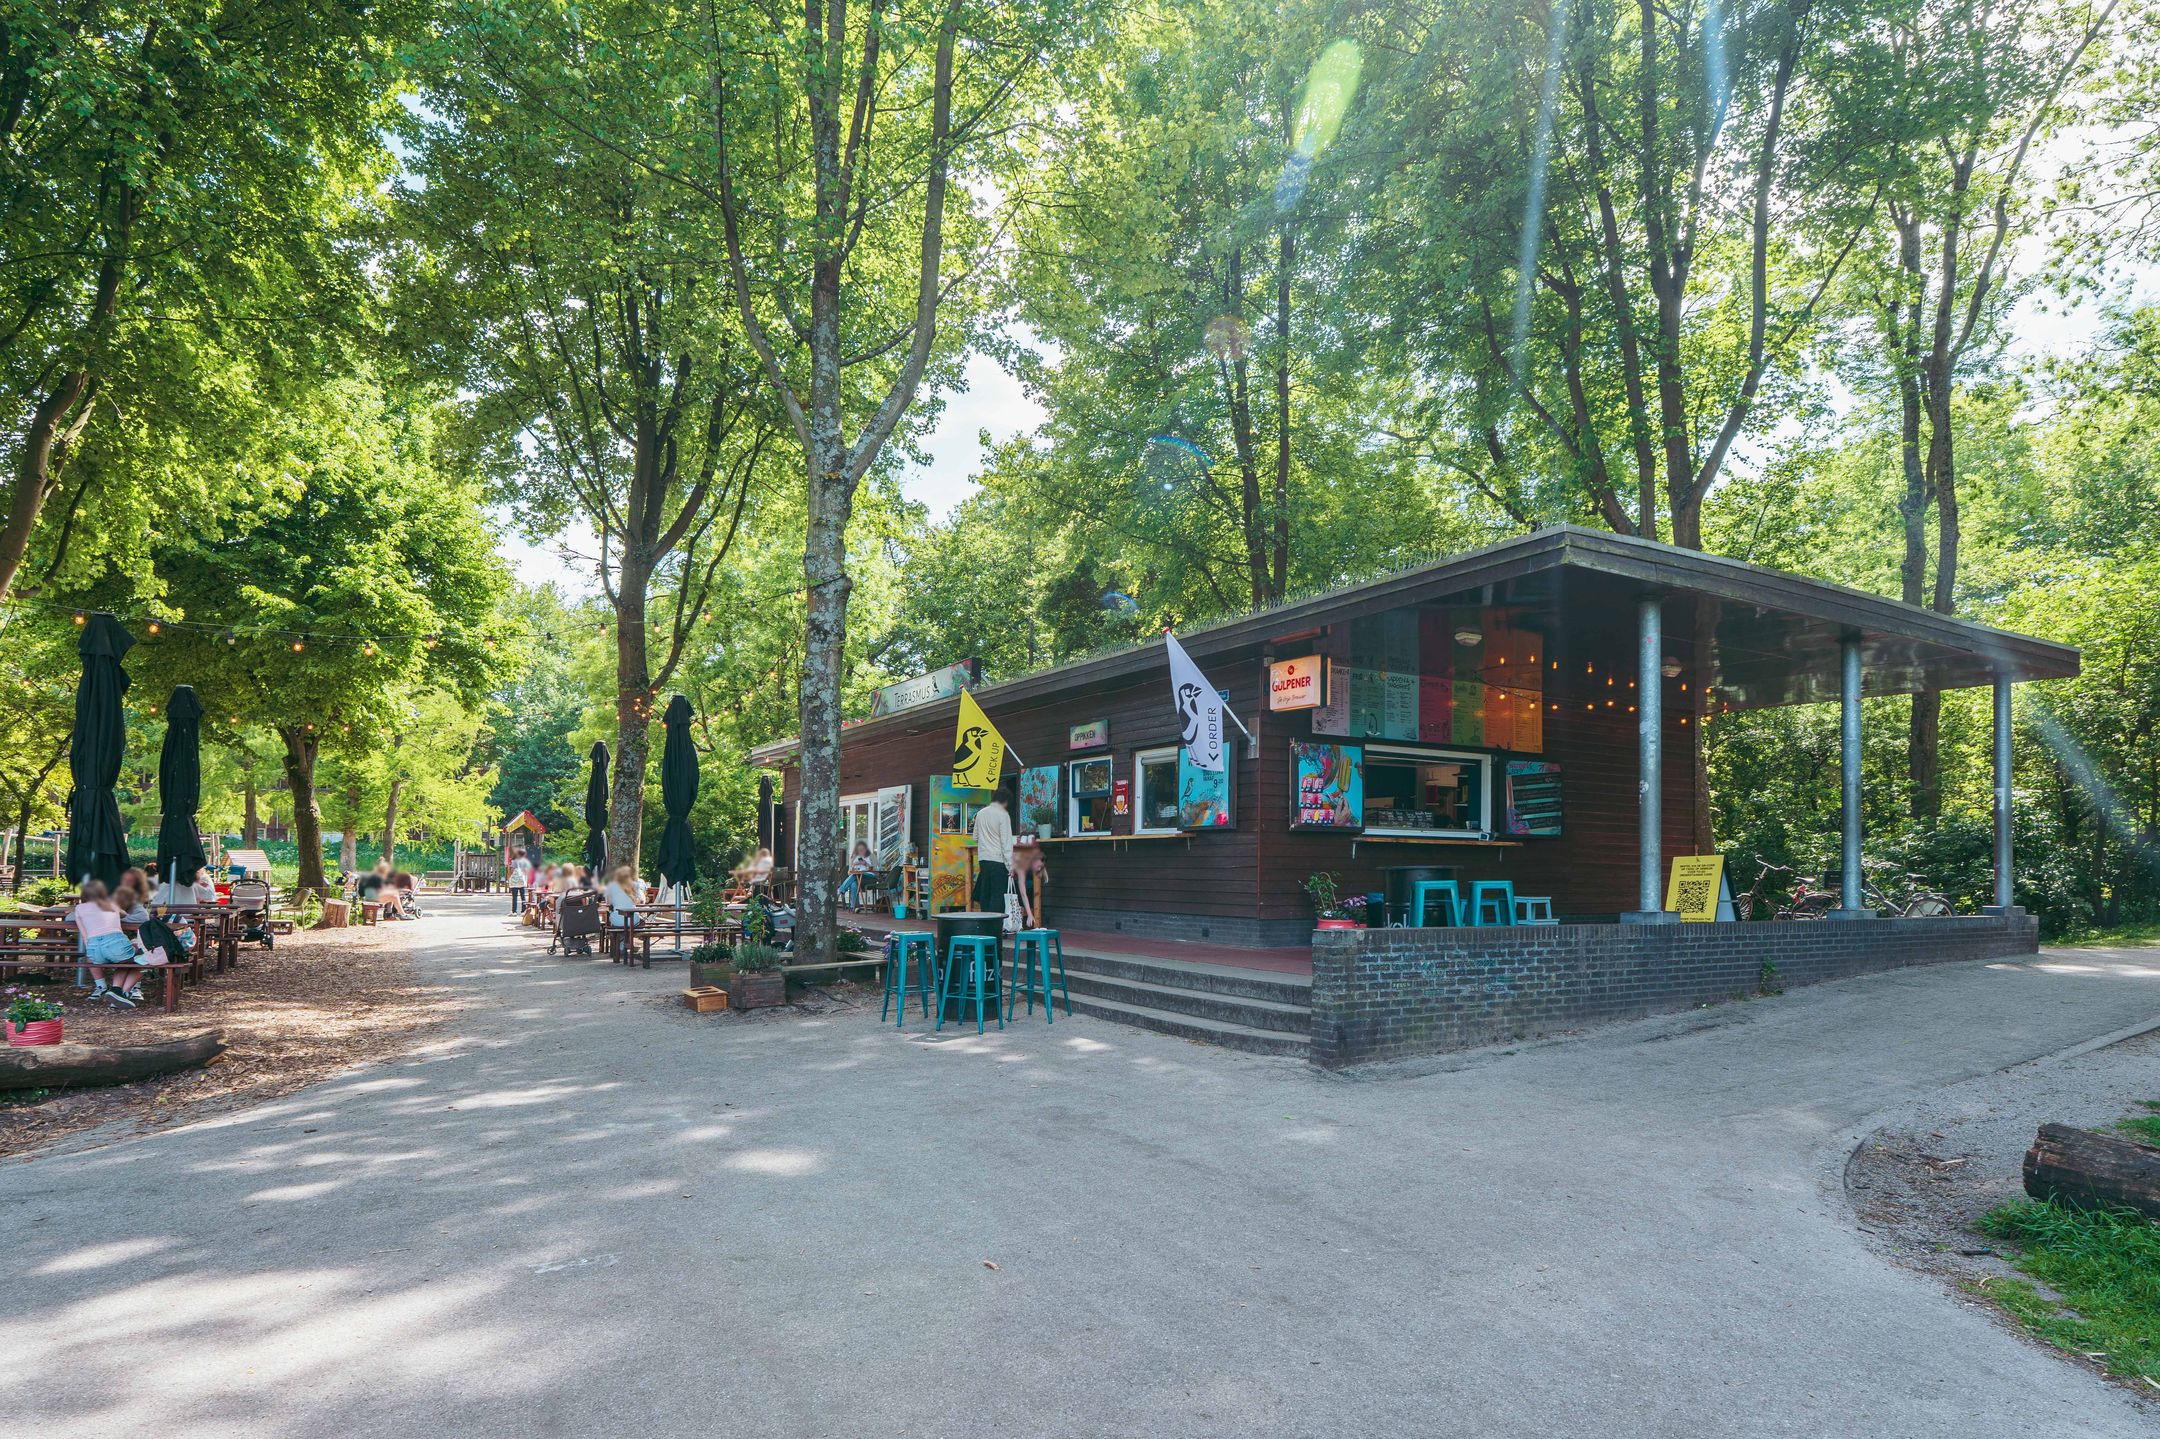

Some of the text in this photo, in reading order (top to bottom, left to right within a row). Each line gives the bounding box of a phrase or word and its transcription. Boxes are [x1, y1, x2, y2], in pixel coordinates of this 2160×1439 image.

[894, 686, 931, 708] TERRASMUS
[1272, 676, 1311, 692] GULPENER
[1208, 707, 1217, 749] ORDER
[987, 742, 1000, 775] PICK UP
